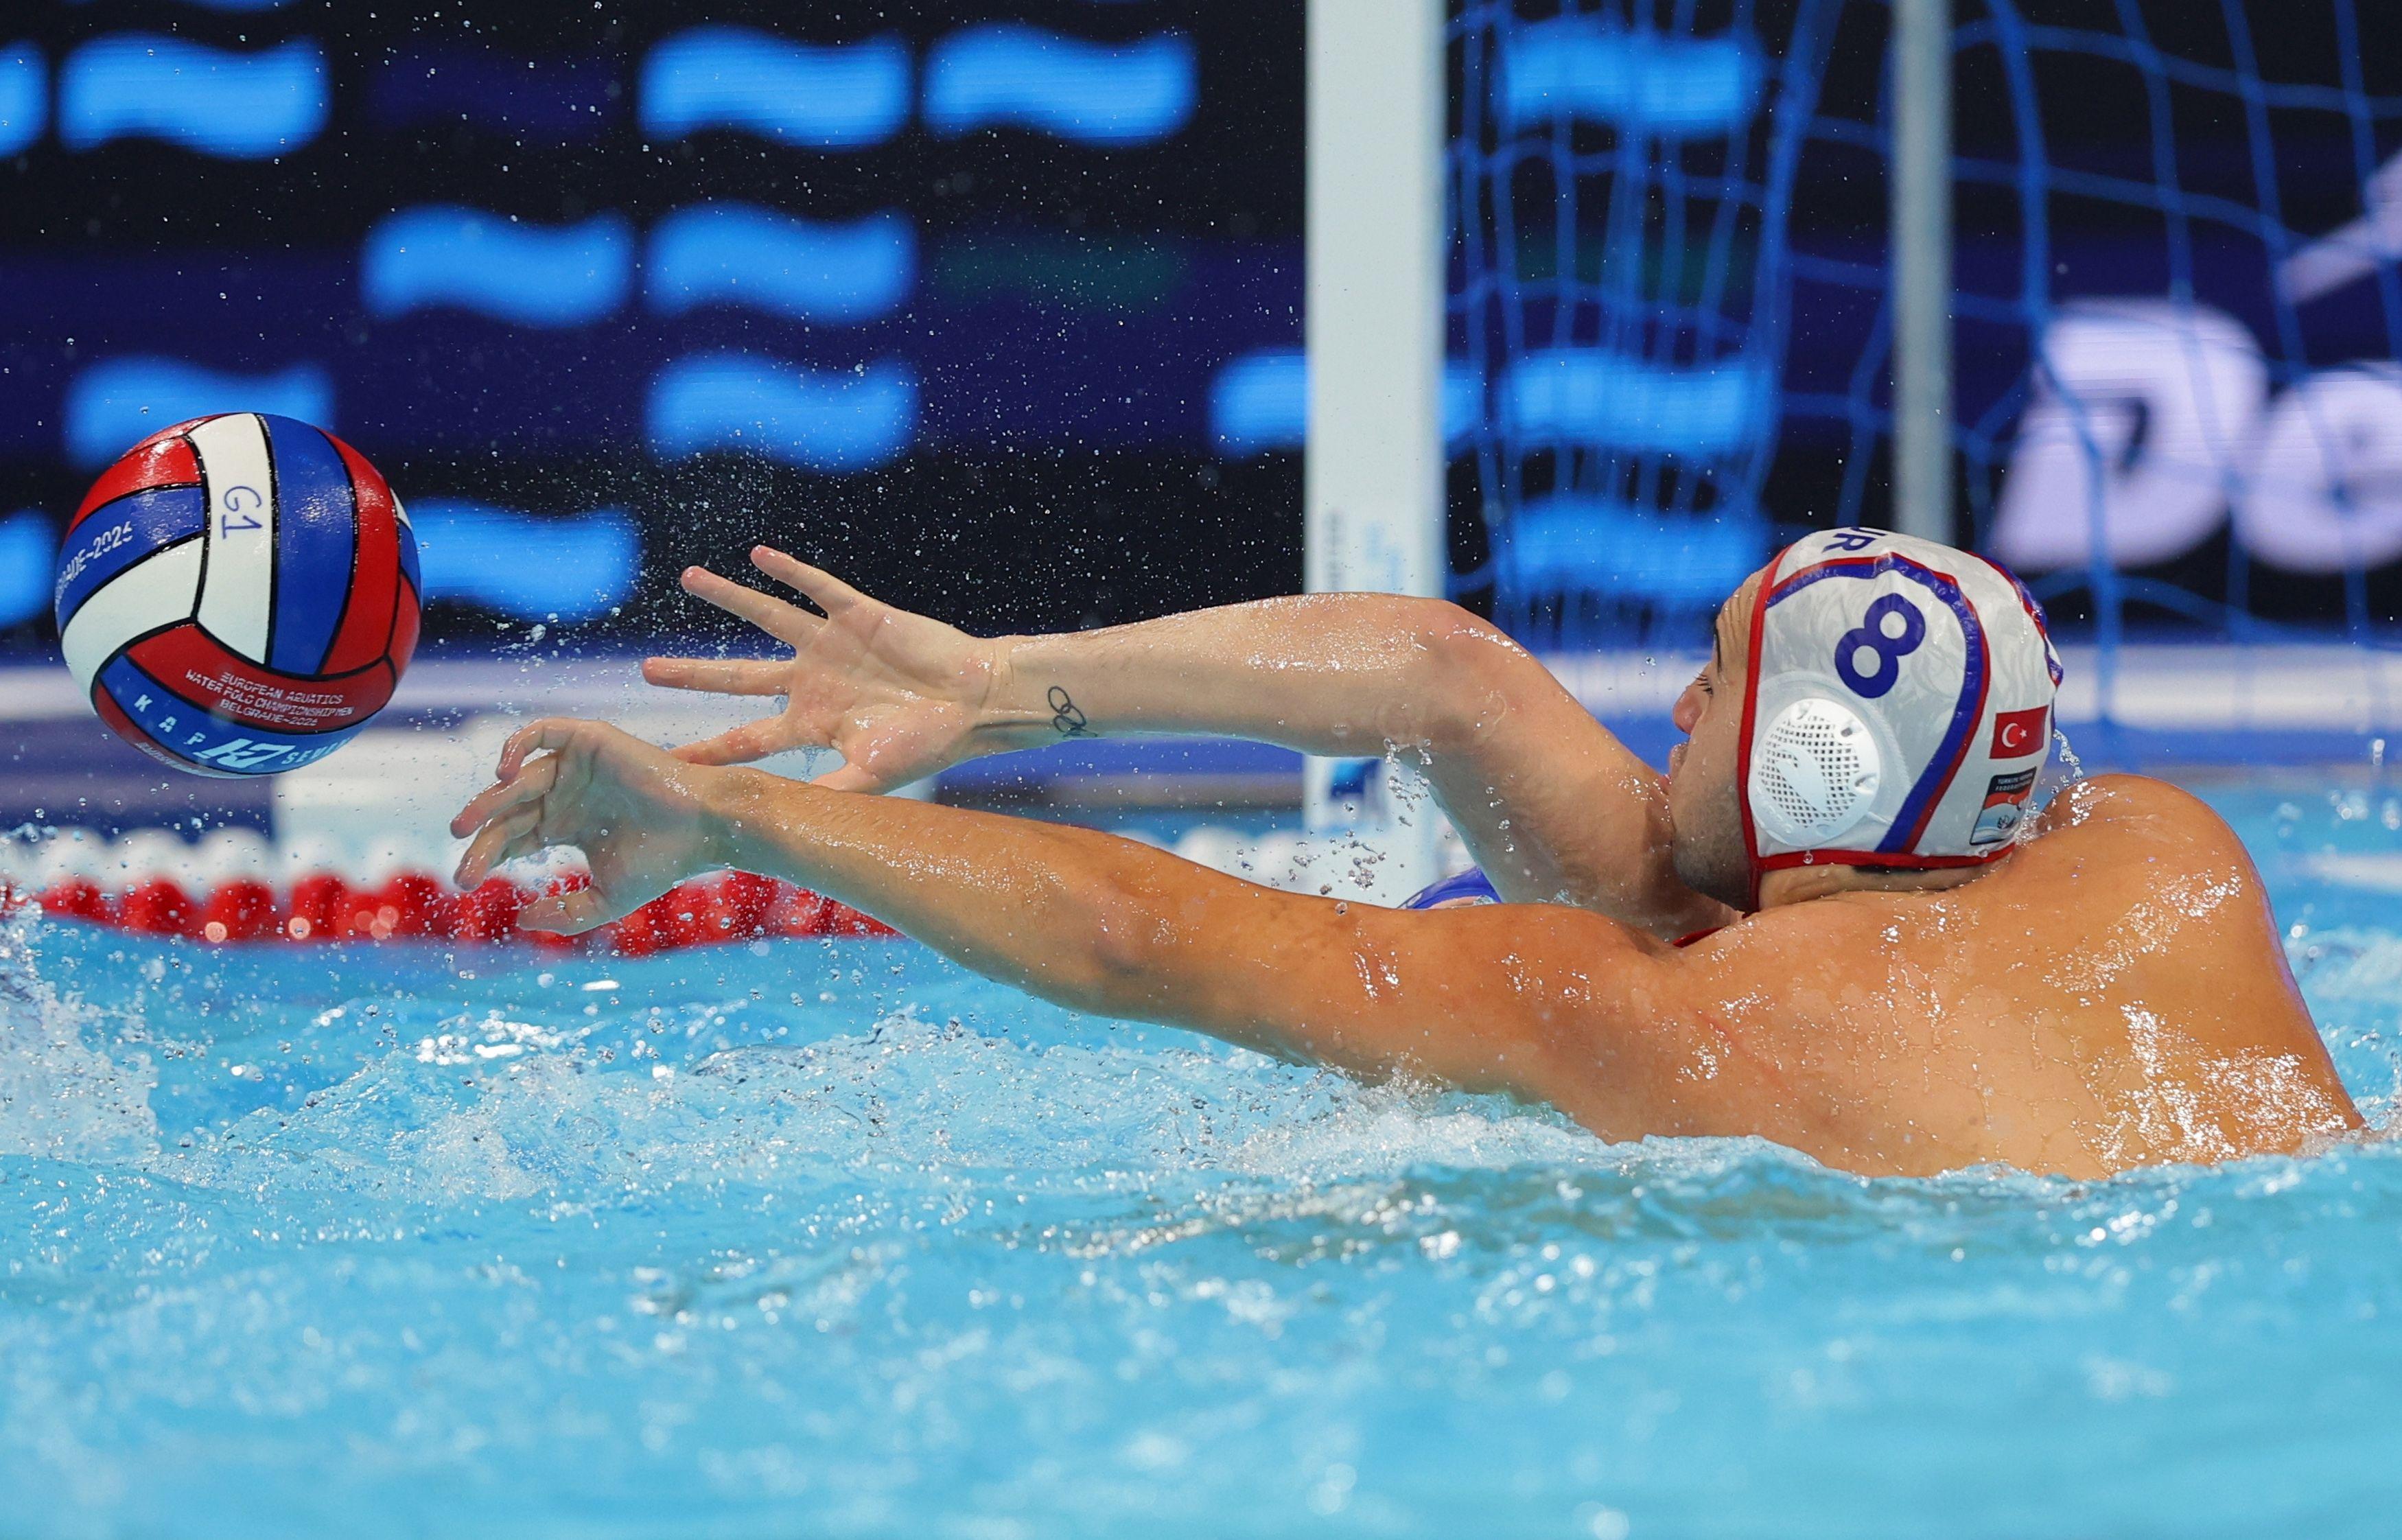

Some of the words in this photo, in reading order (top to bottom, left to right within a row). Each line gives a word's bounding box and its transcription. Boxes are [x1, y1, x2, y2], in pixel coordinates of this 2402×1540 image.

[222, 486, 262, 539] G1
[1835, 593, 1926, 699] 8
[185, 669, 224, 693] WATER
[222, 686, 255, 704] POLO
[220, 672, 284, 699] EUROPEAN
[285, 691, 343, 705] AQUATICS
